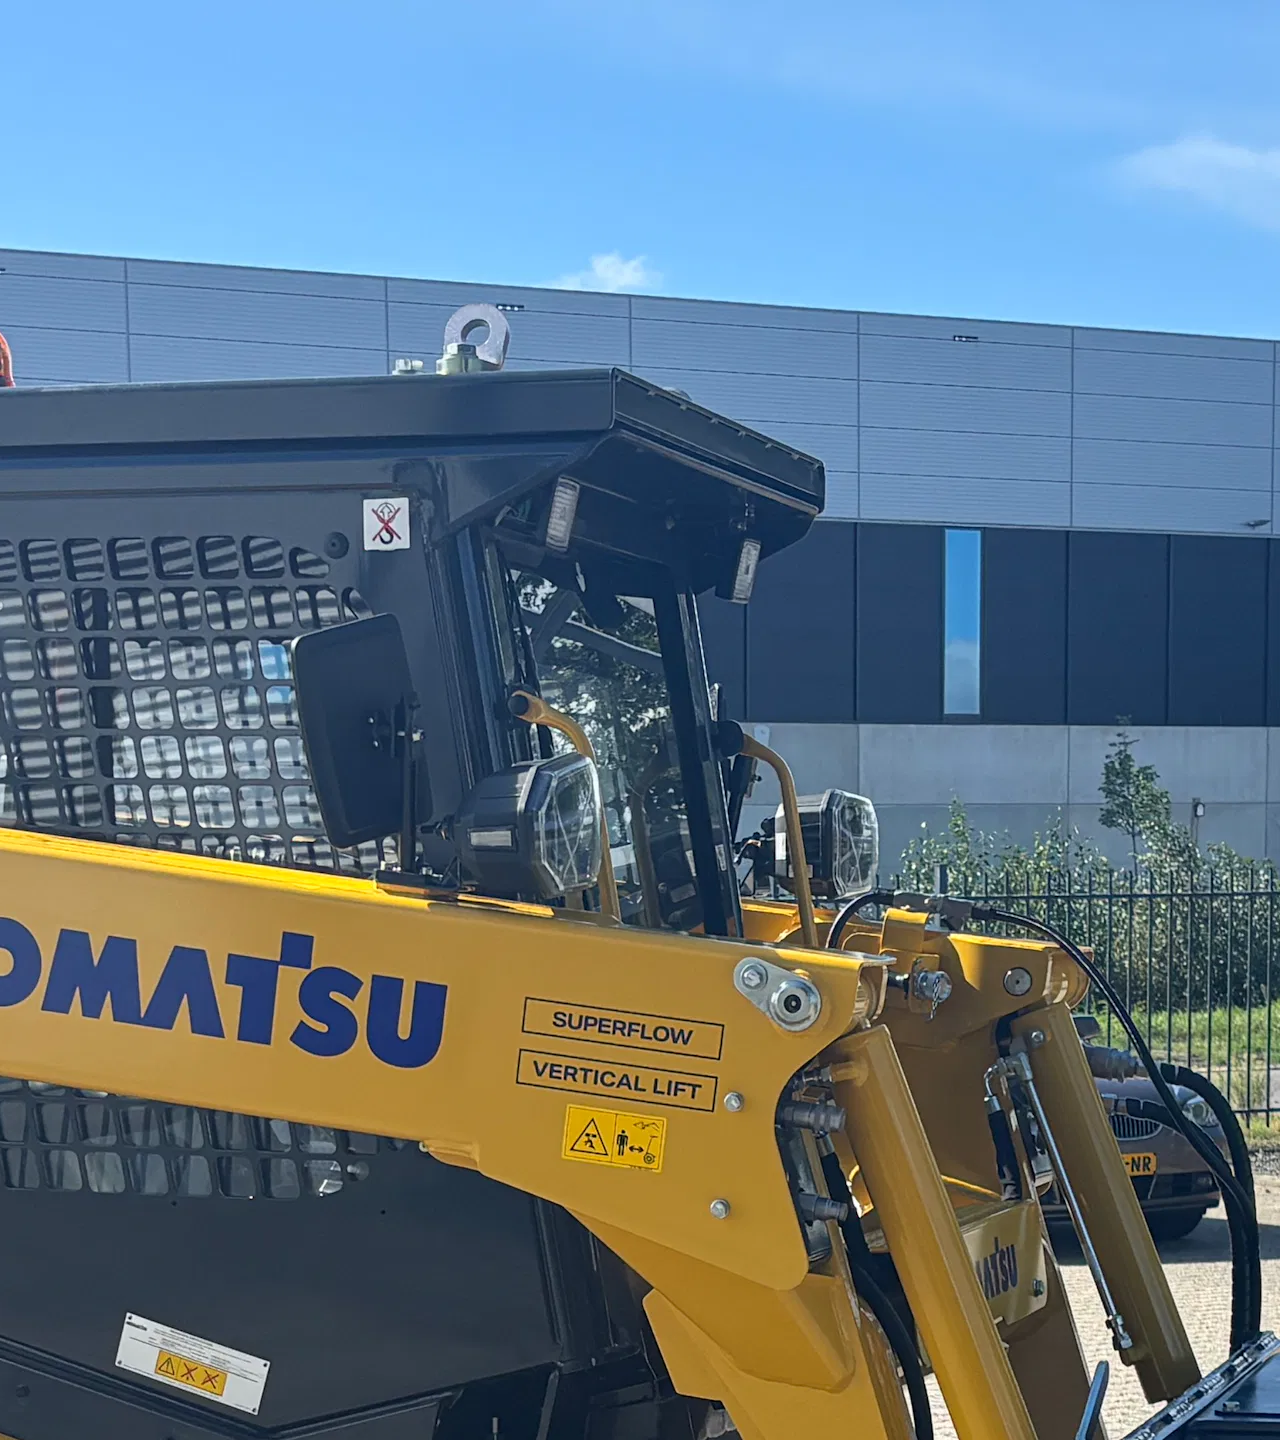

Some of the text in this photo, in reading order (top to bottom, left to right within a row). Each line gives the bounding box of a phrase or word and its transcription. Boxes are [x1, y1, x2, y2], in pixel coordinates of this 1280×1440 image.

[552, 1011, 694, 1046] SUPERFLOW
[533, 1060, 703, 1100] VERTICAL LIFT
[1125, 1156, 1152, 1173] -NR
